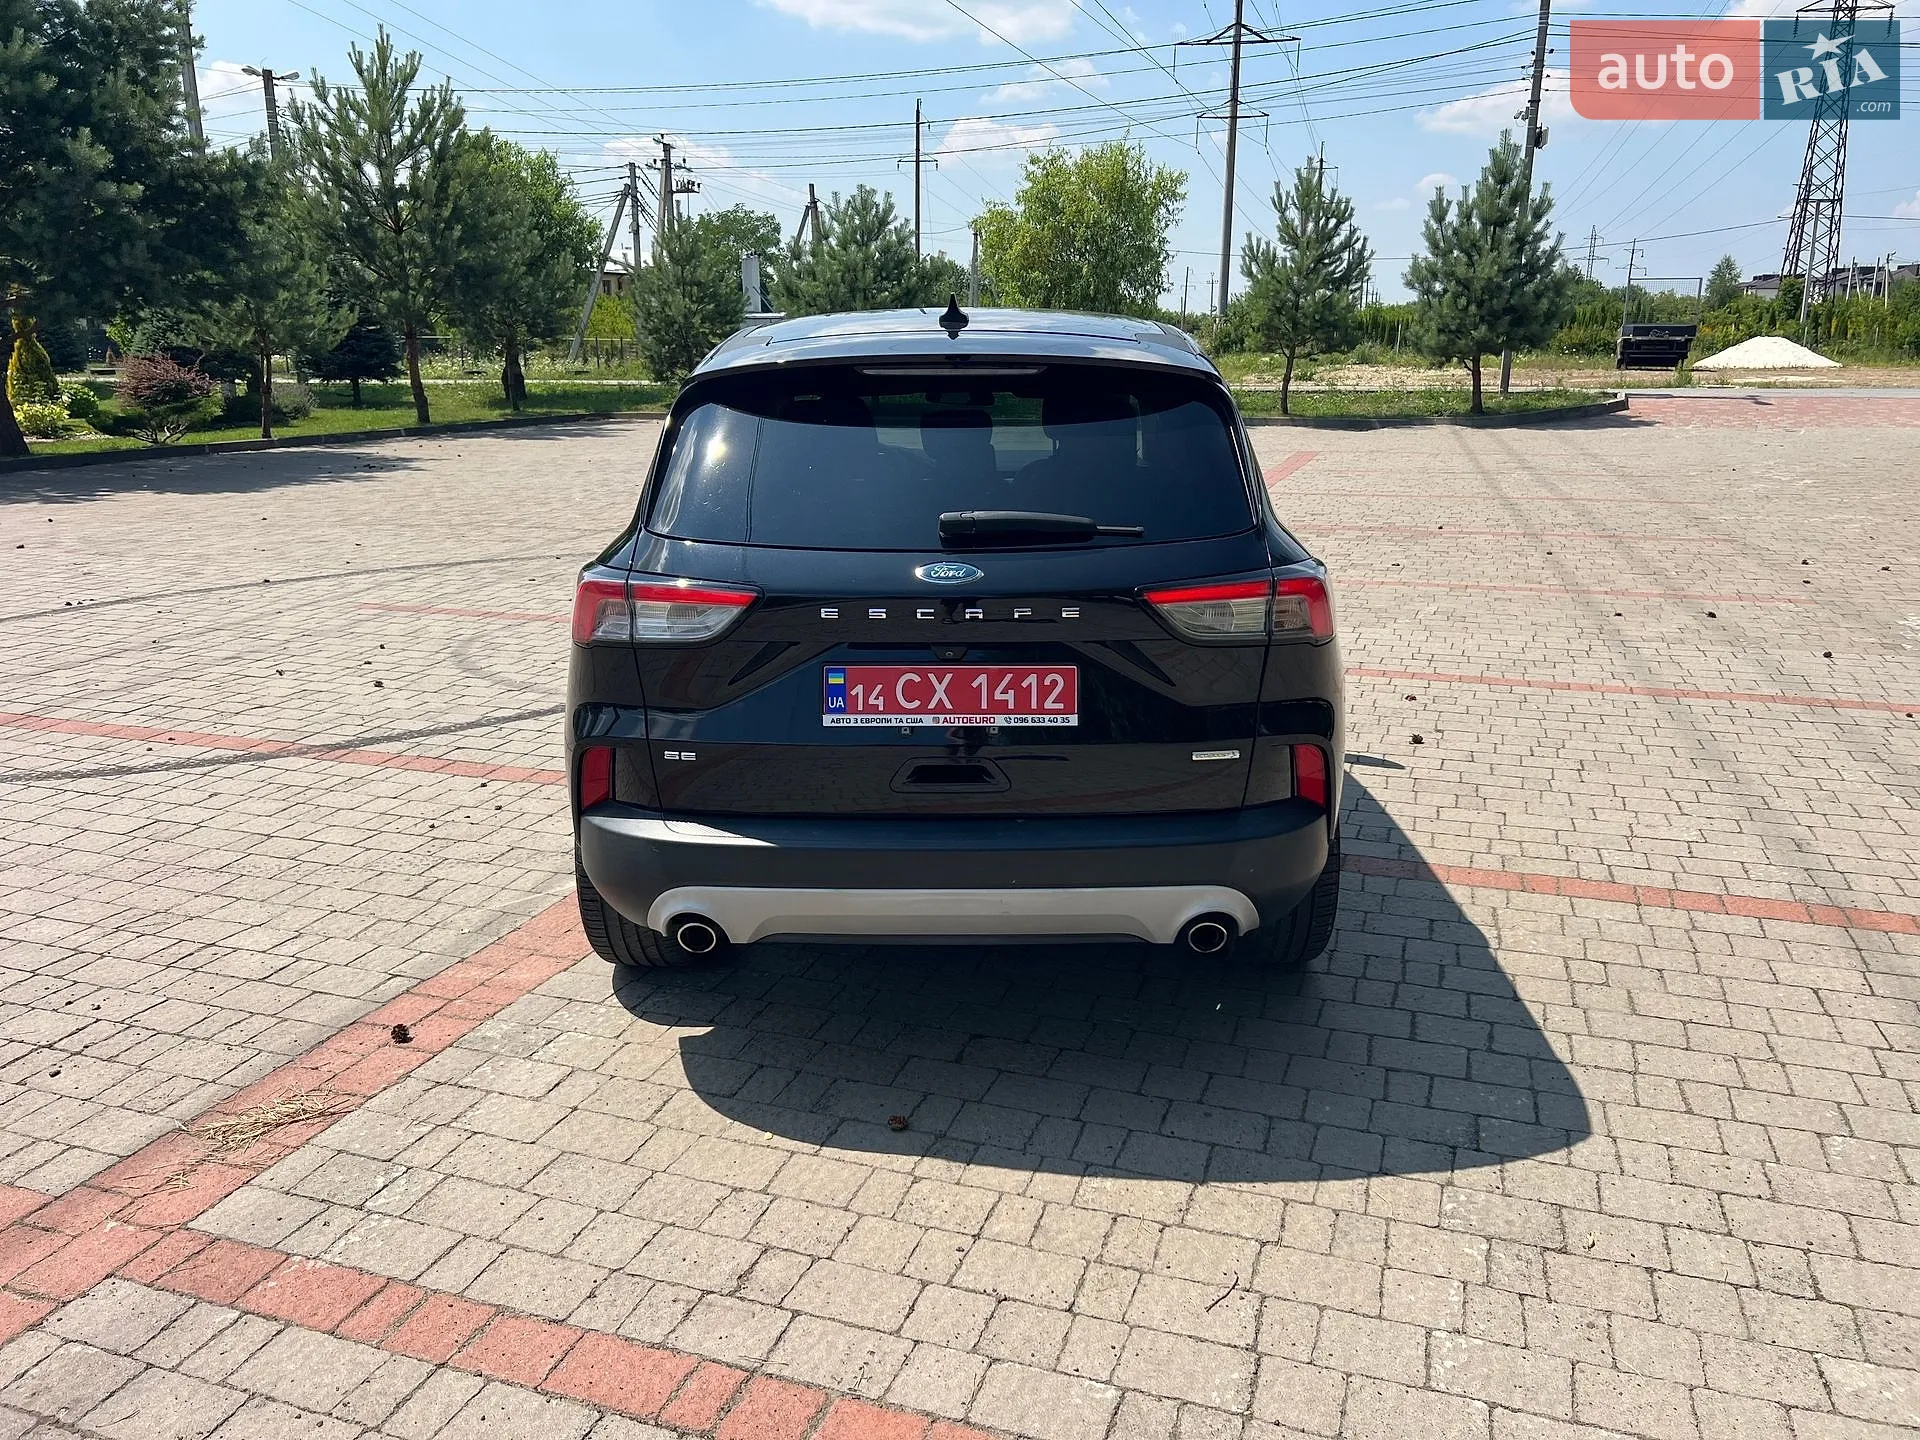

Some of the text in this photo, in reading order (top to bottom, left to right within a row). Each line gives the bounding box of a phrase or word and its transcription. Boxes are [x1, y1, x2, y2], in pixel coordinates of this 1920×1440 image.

[930, 564, 966, 578] Ford
[820, 607, 1080, 619] ESCAPE
[850, 672, 1065, 710] 14 CX 1412
[828, 697, 844, 708] UA
[942, 716, 996, 724] AUTOEURO
[1013, 716, 1071, 724] 096 633 40 35
[664, 751, 697, 760] SE
